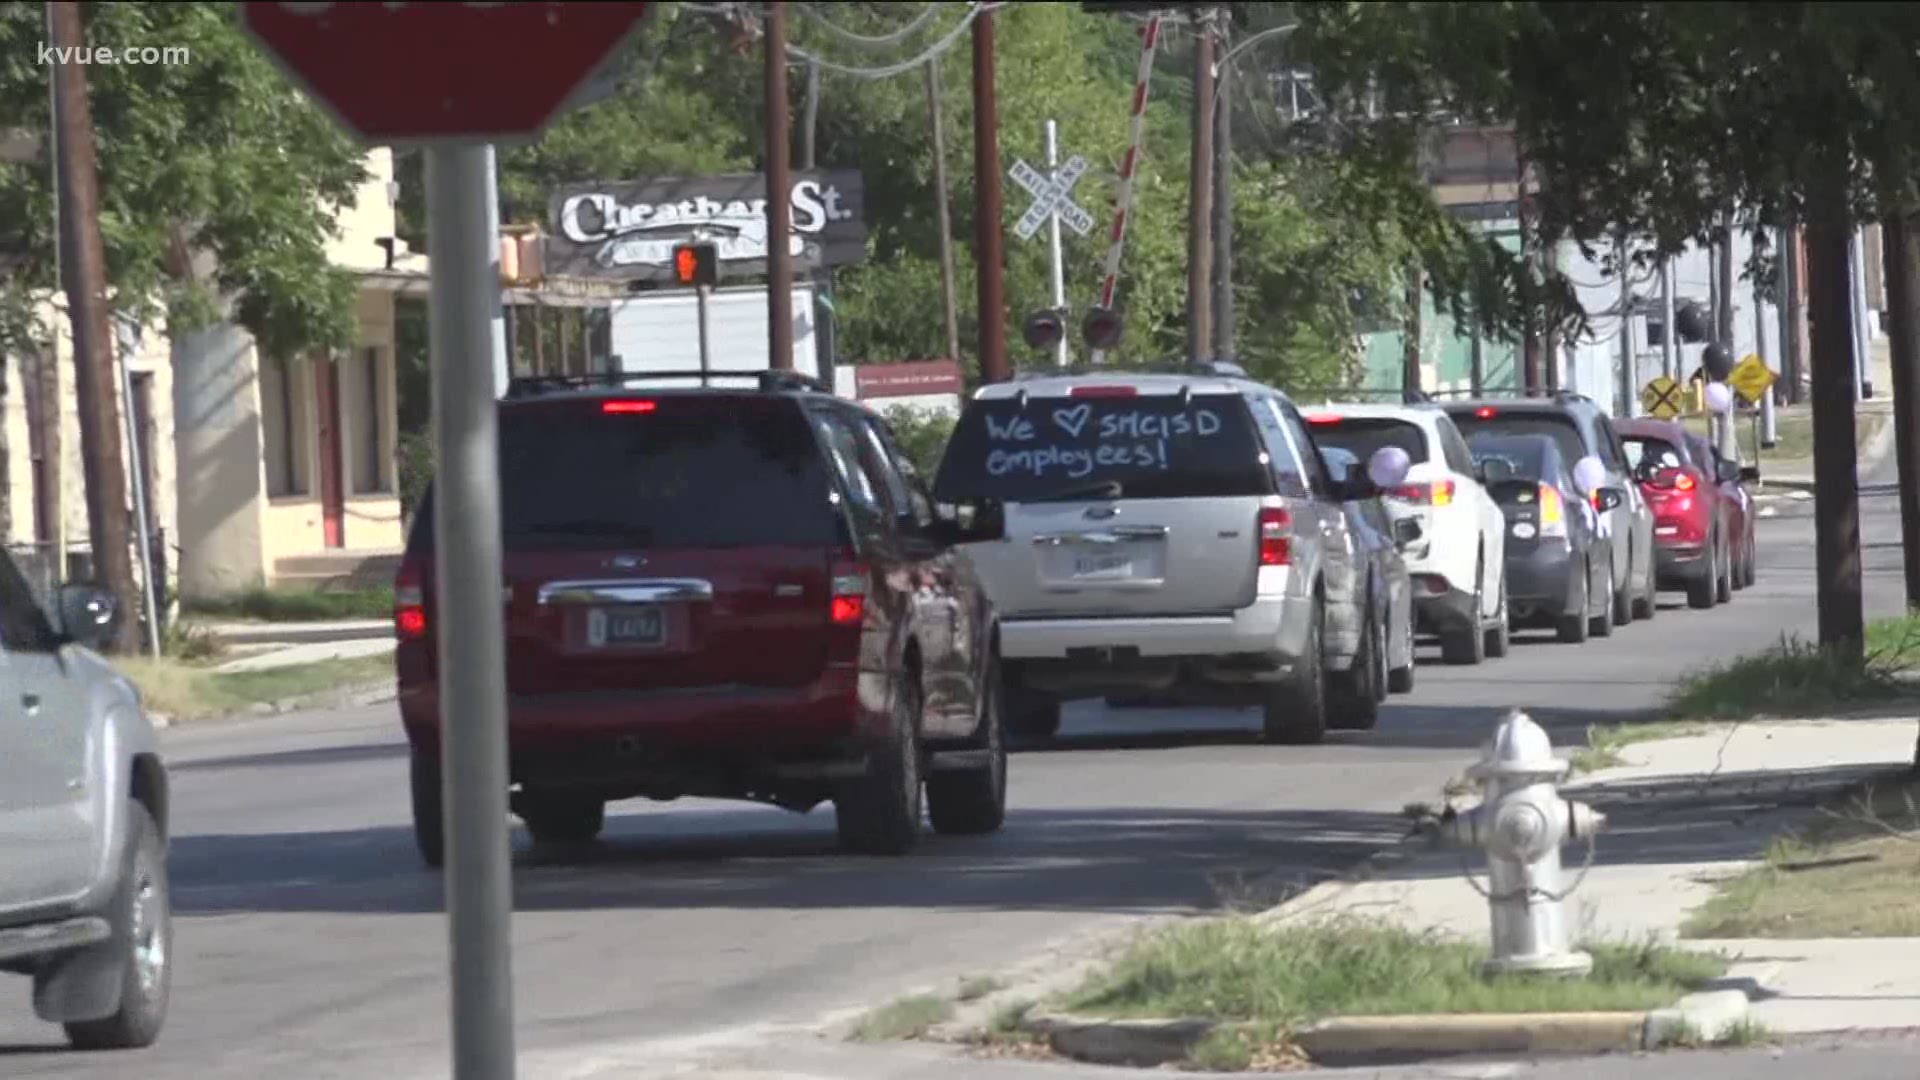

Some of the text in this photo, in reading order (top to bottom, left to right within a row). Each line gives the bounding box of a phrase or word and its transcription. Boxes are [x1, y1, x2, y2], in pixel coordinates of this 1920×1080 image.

[788, 181, 852, 232] St.
[985, 414, 1036, 440] We
[986, 440, 1168, 477] employees!
